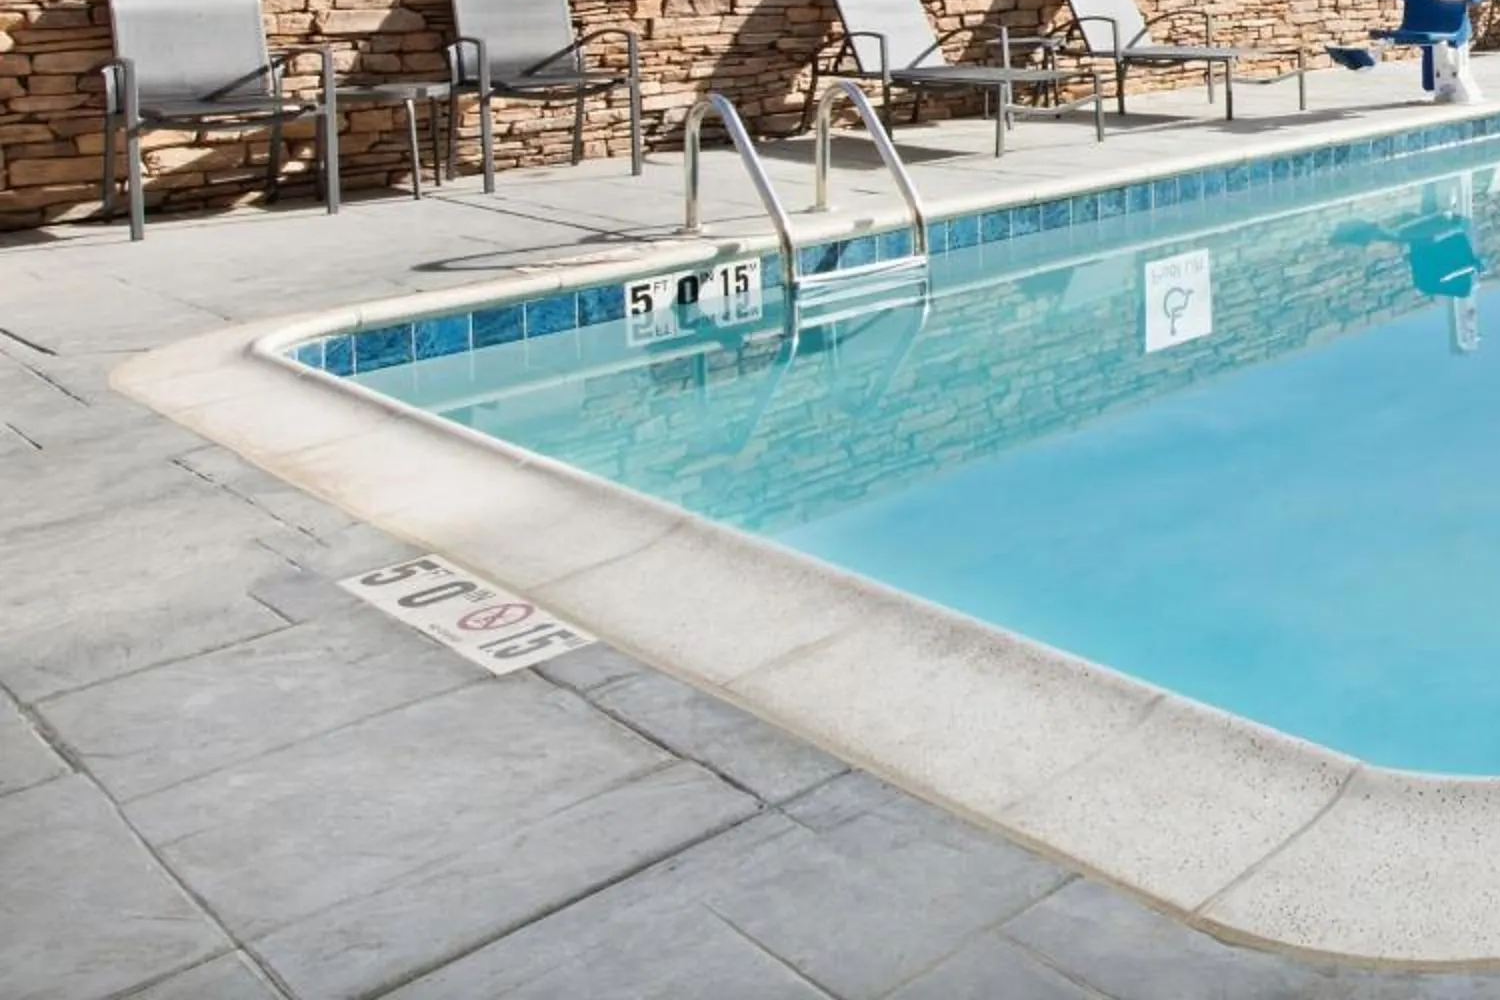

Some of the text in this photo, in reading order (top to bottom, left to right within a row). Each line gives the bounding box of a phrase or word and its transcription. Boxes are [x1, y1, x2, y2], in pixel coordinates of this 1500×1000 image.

[631, 283, 653, 315] 5
[653, 279, 669, 294] FT
[677, 275, 699, 305] 0
[360, 559, 440, 587] 5
[397, 581, 477, 608] 0
